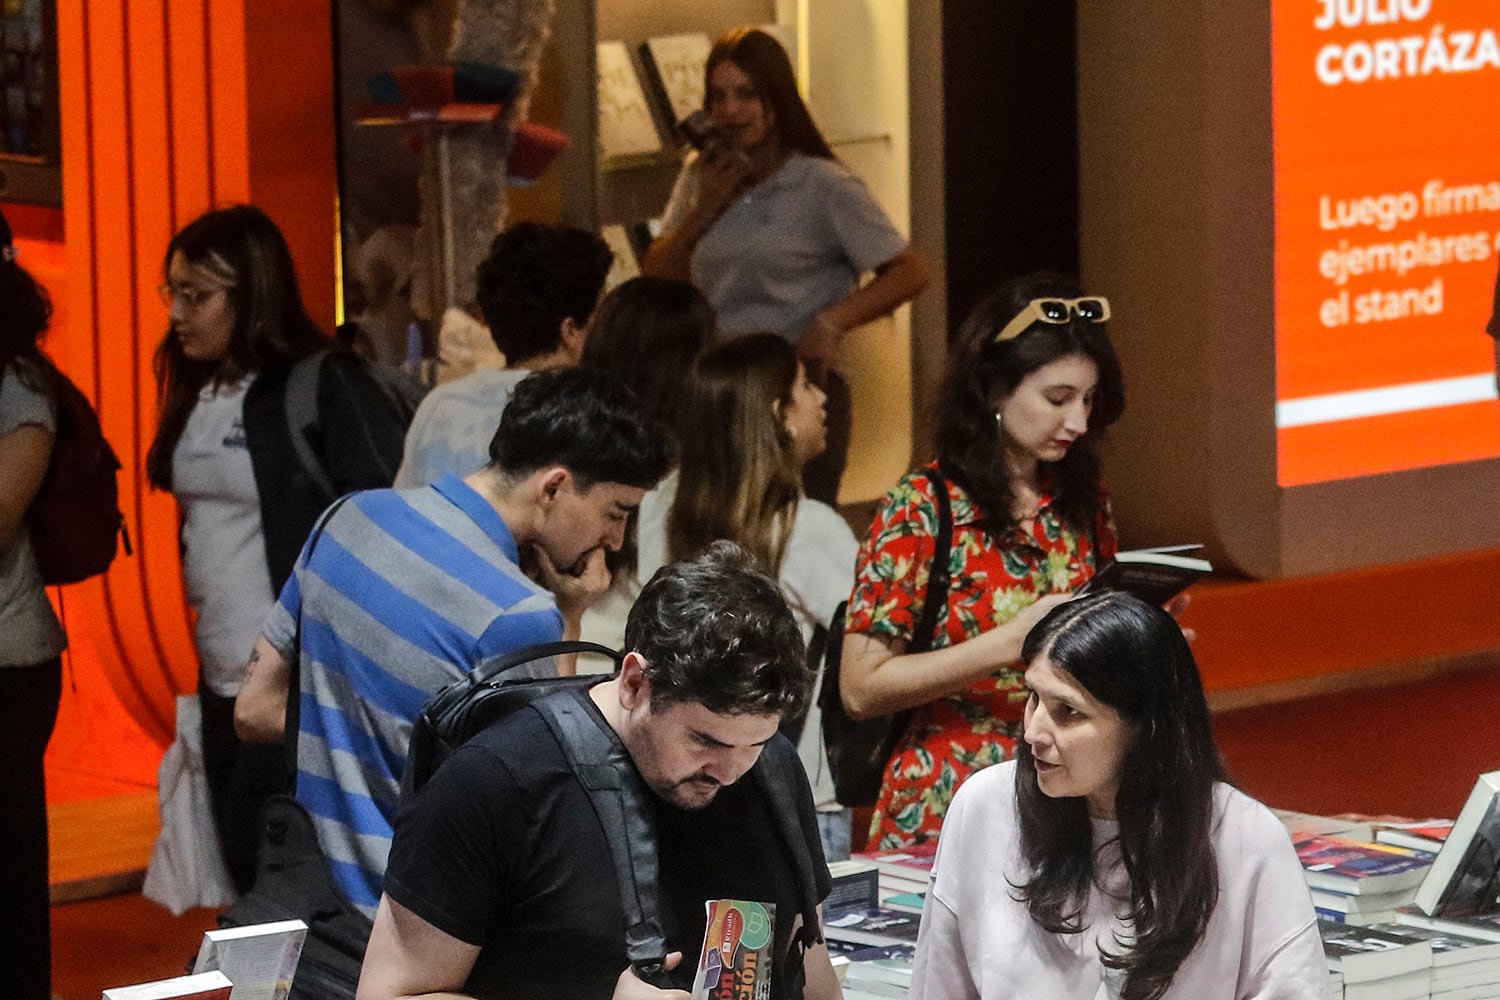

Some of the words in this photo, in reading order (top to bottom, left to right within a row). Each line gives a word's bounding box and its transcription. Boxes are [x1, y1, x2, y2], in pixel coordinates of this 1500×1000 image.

[1314, 0, 1431, 29] JULIO
[1319, 193, 1419, 231] Luego
[1319, 230, 1491, 286] ejemplares
[1320, 288, 1349, 327] el
[1354, 276, 1443, 325] stand
